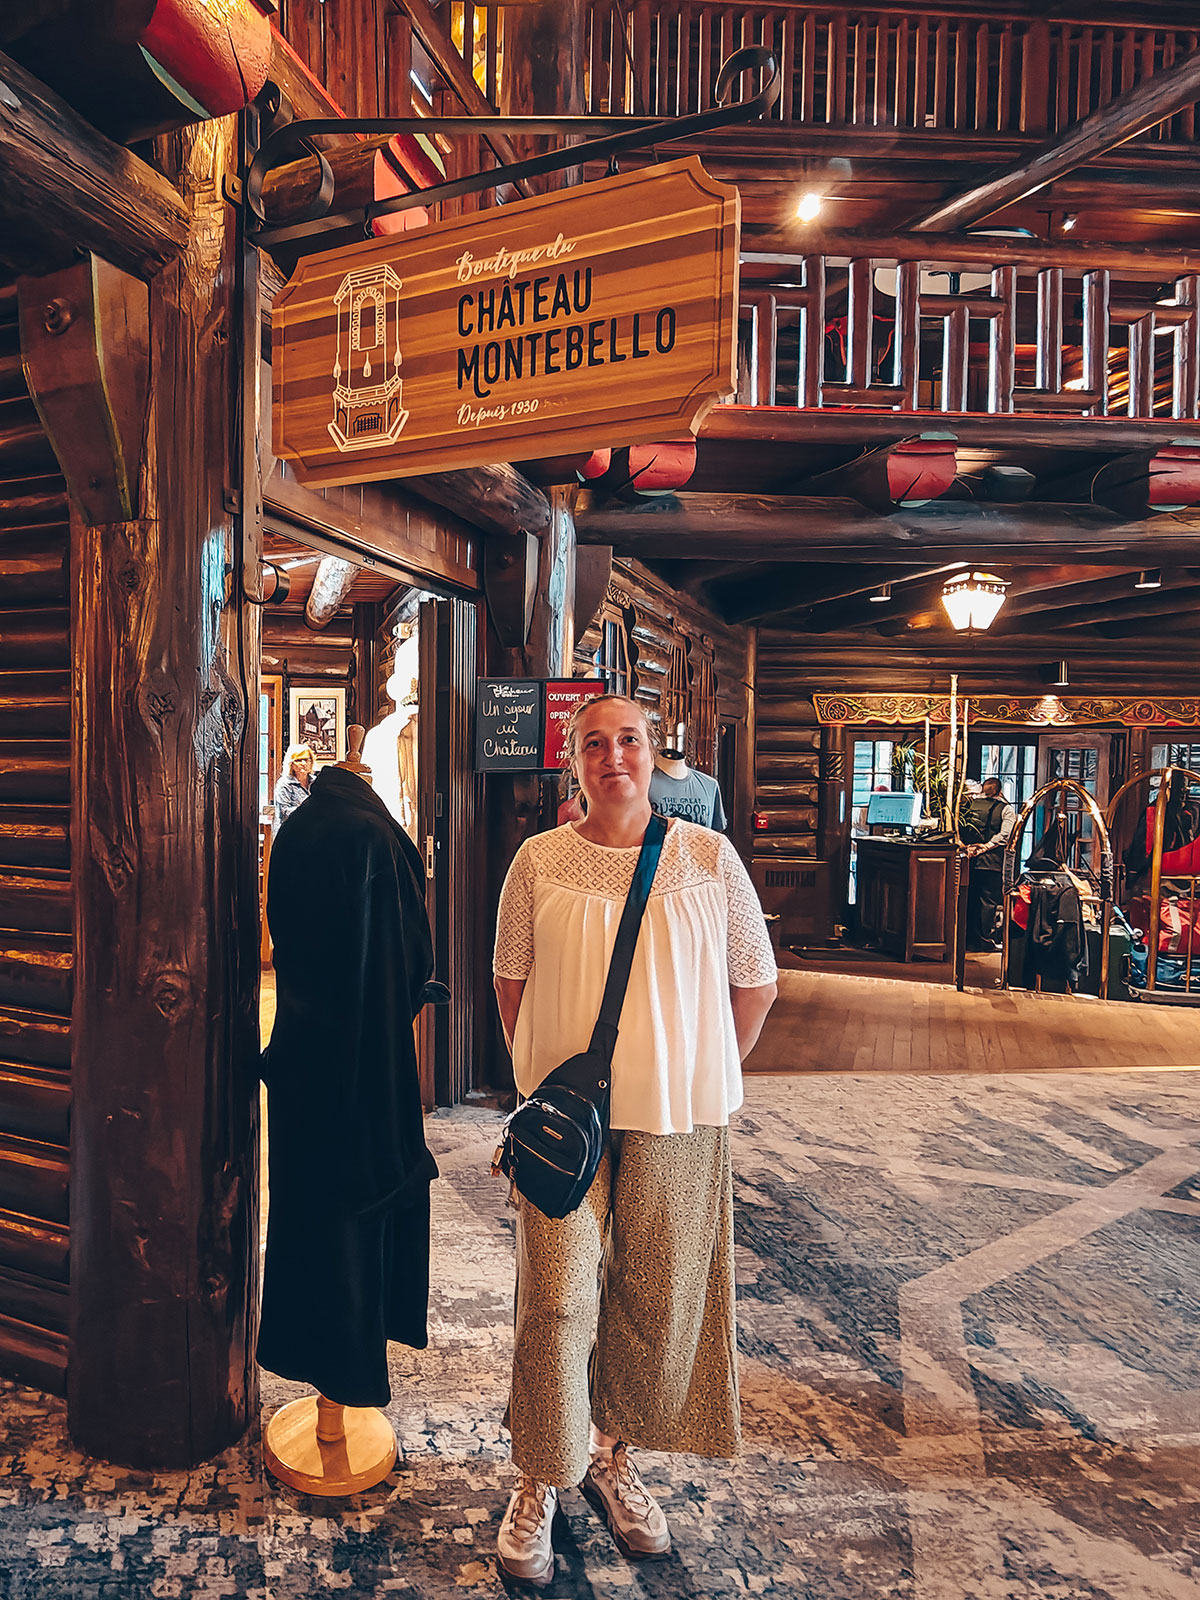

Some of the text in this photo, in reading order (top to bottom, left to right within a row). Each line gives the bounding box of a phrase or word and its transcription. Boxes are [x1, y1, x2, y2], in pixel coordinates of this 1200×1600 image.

[456, 232, 577, 281] Boutique du
[458, 267, 592, 337] CHÂTEAU
[457, 307, 676, 399] MONTEBELLO
[457, 402, 509, 427] Depuis
[509, 395, 539, 416] 1930
[548, 693, 580, 702] OUVERT
[483, 701, 500, 716] Un
[550, 711, 570, 719] OPEN
[496, 724, 518, 735] au
[484, 738, 537, 757] Château
